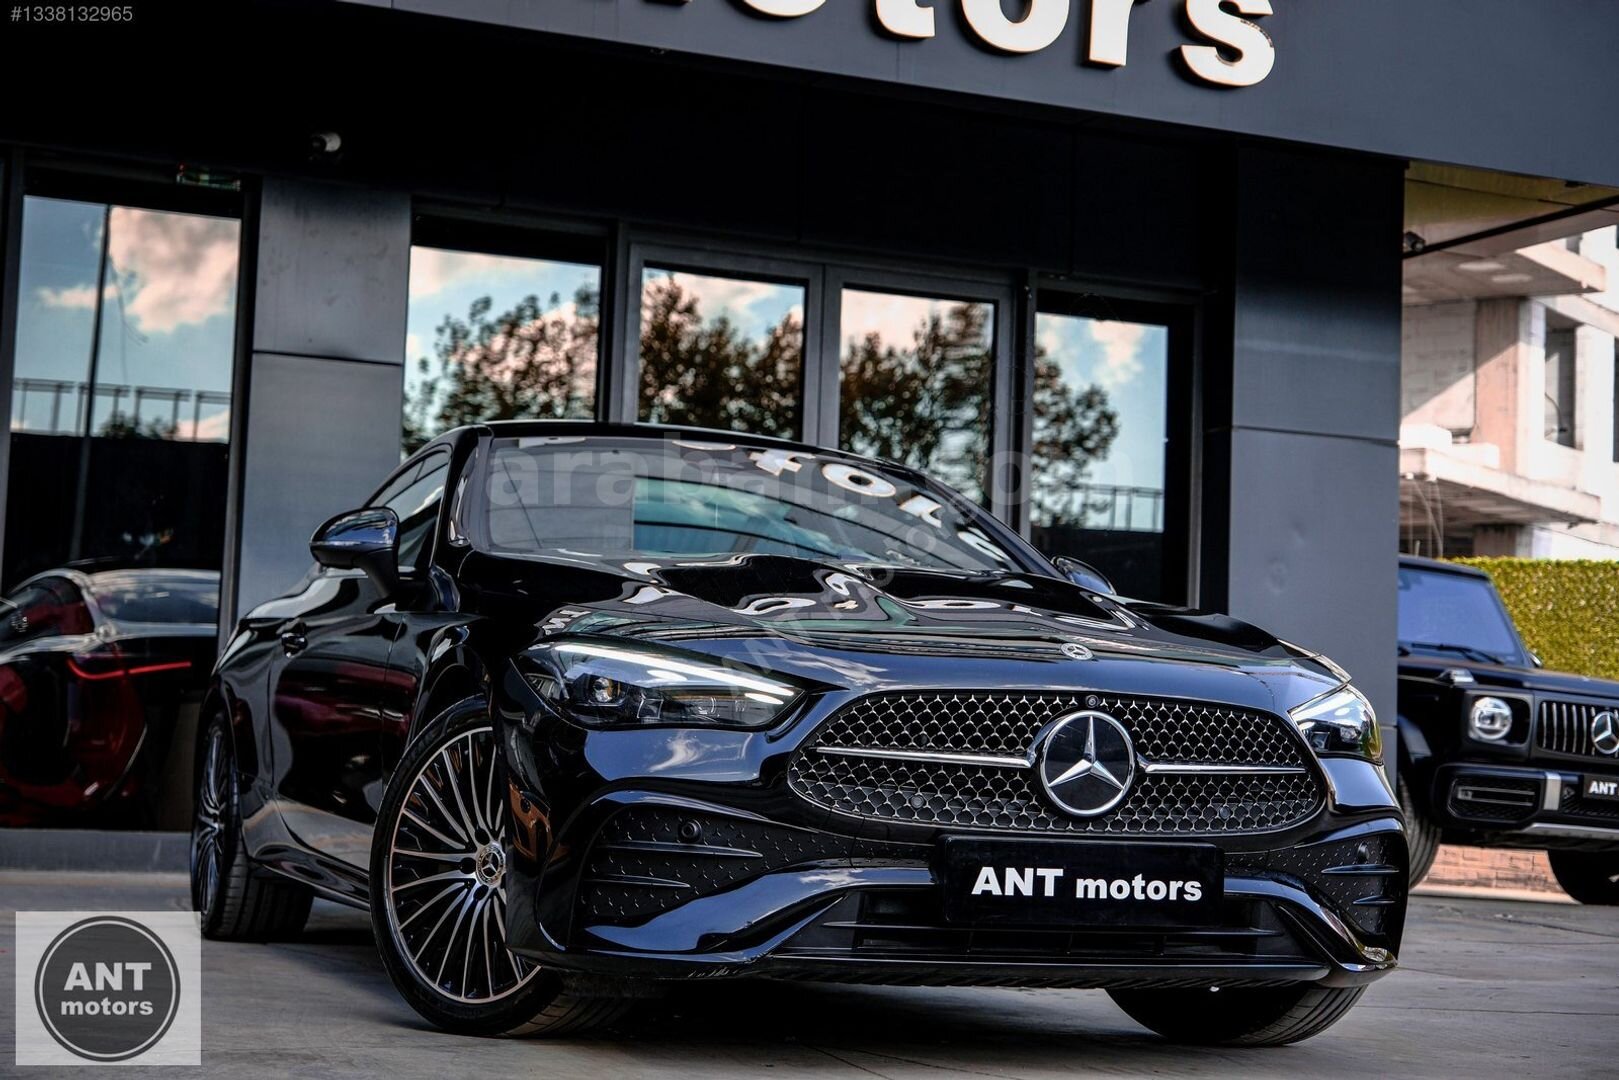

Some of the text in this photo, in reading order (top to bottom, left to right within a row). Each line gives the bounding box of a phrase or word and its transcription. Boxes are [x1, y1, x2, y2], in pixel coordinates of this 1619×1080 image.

[1588, 780, 1618, 796] ANT
[971, 866, 1202, 901] ANT motors
